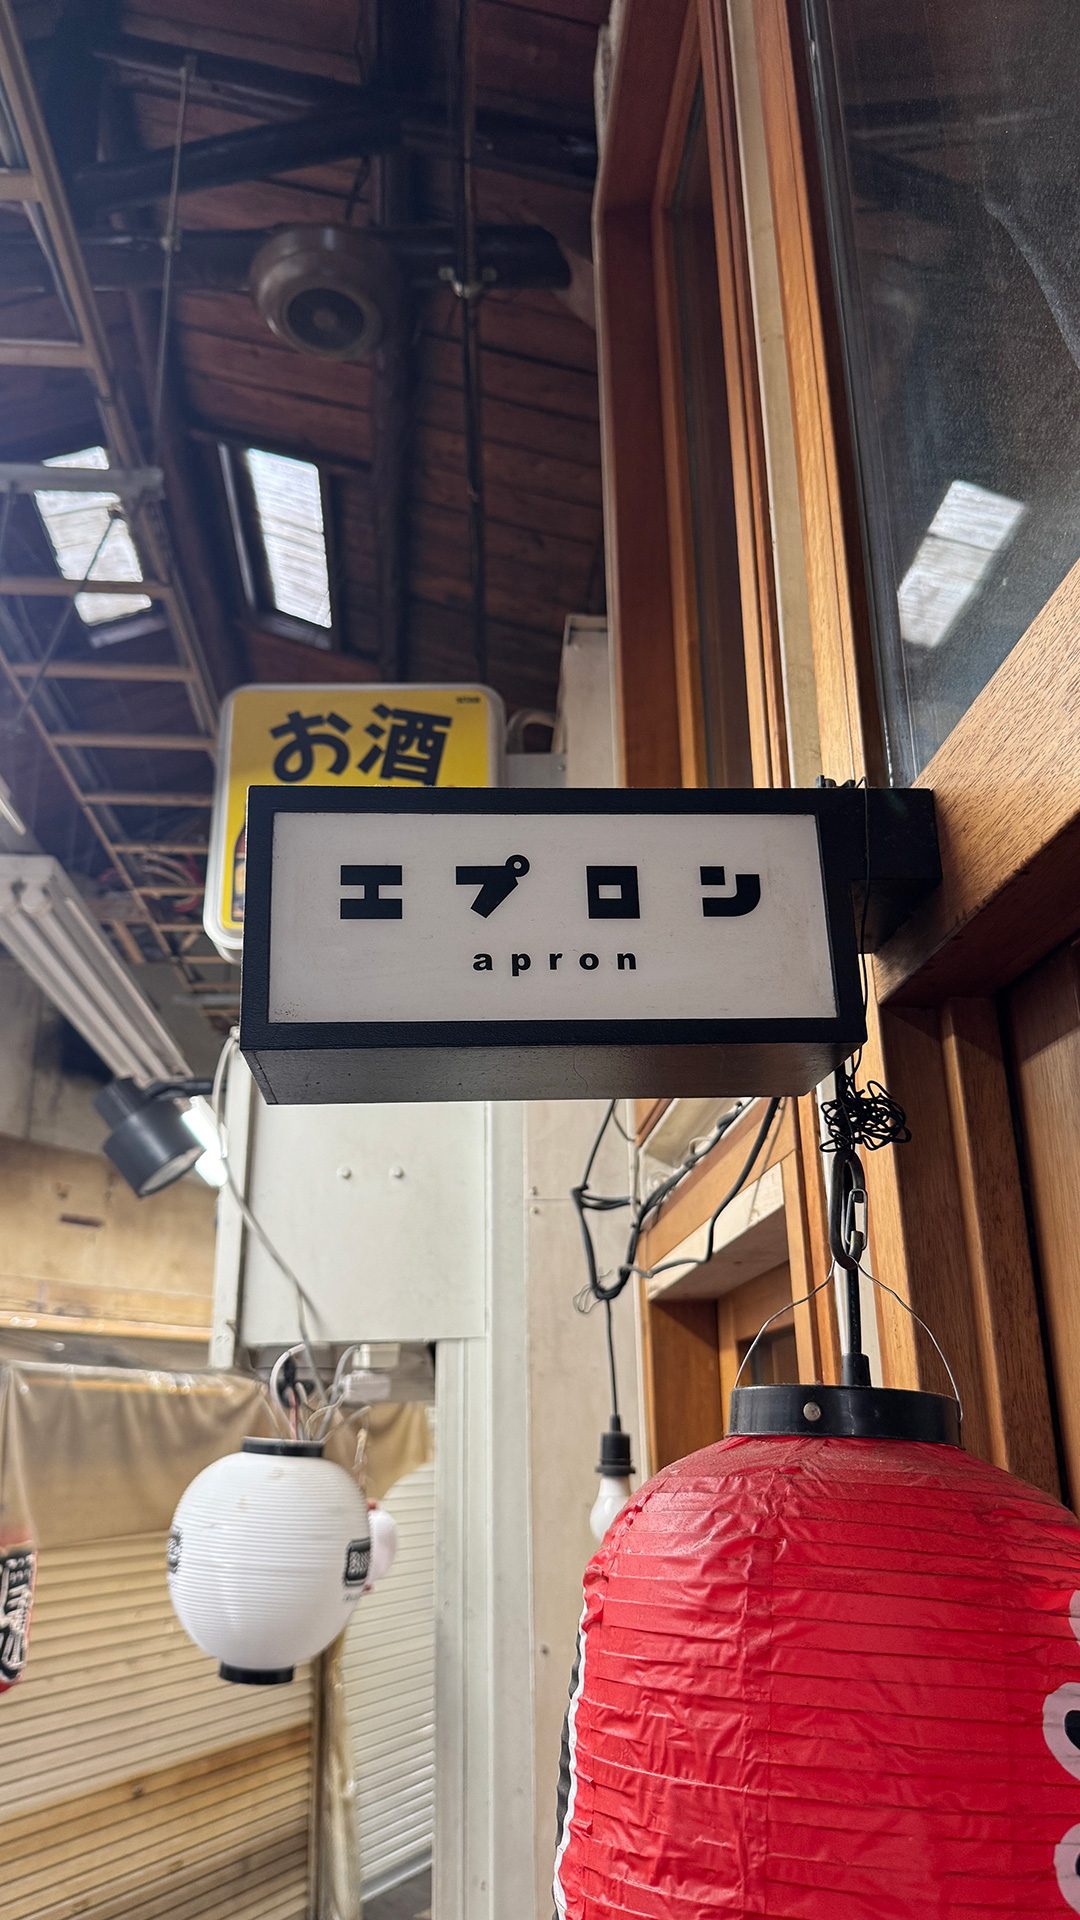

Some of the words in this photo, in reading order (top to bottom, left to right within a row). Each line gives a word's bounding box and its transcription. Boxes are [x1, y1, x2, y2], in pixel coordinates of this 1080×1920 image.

[270, 703, 453, 786] お酒
[340, 854, 761, 920] エプロン
[472, 952, 638, 977] apron
